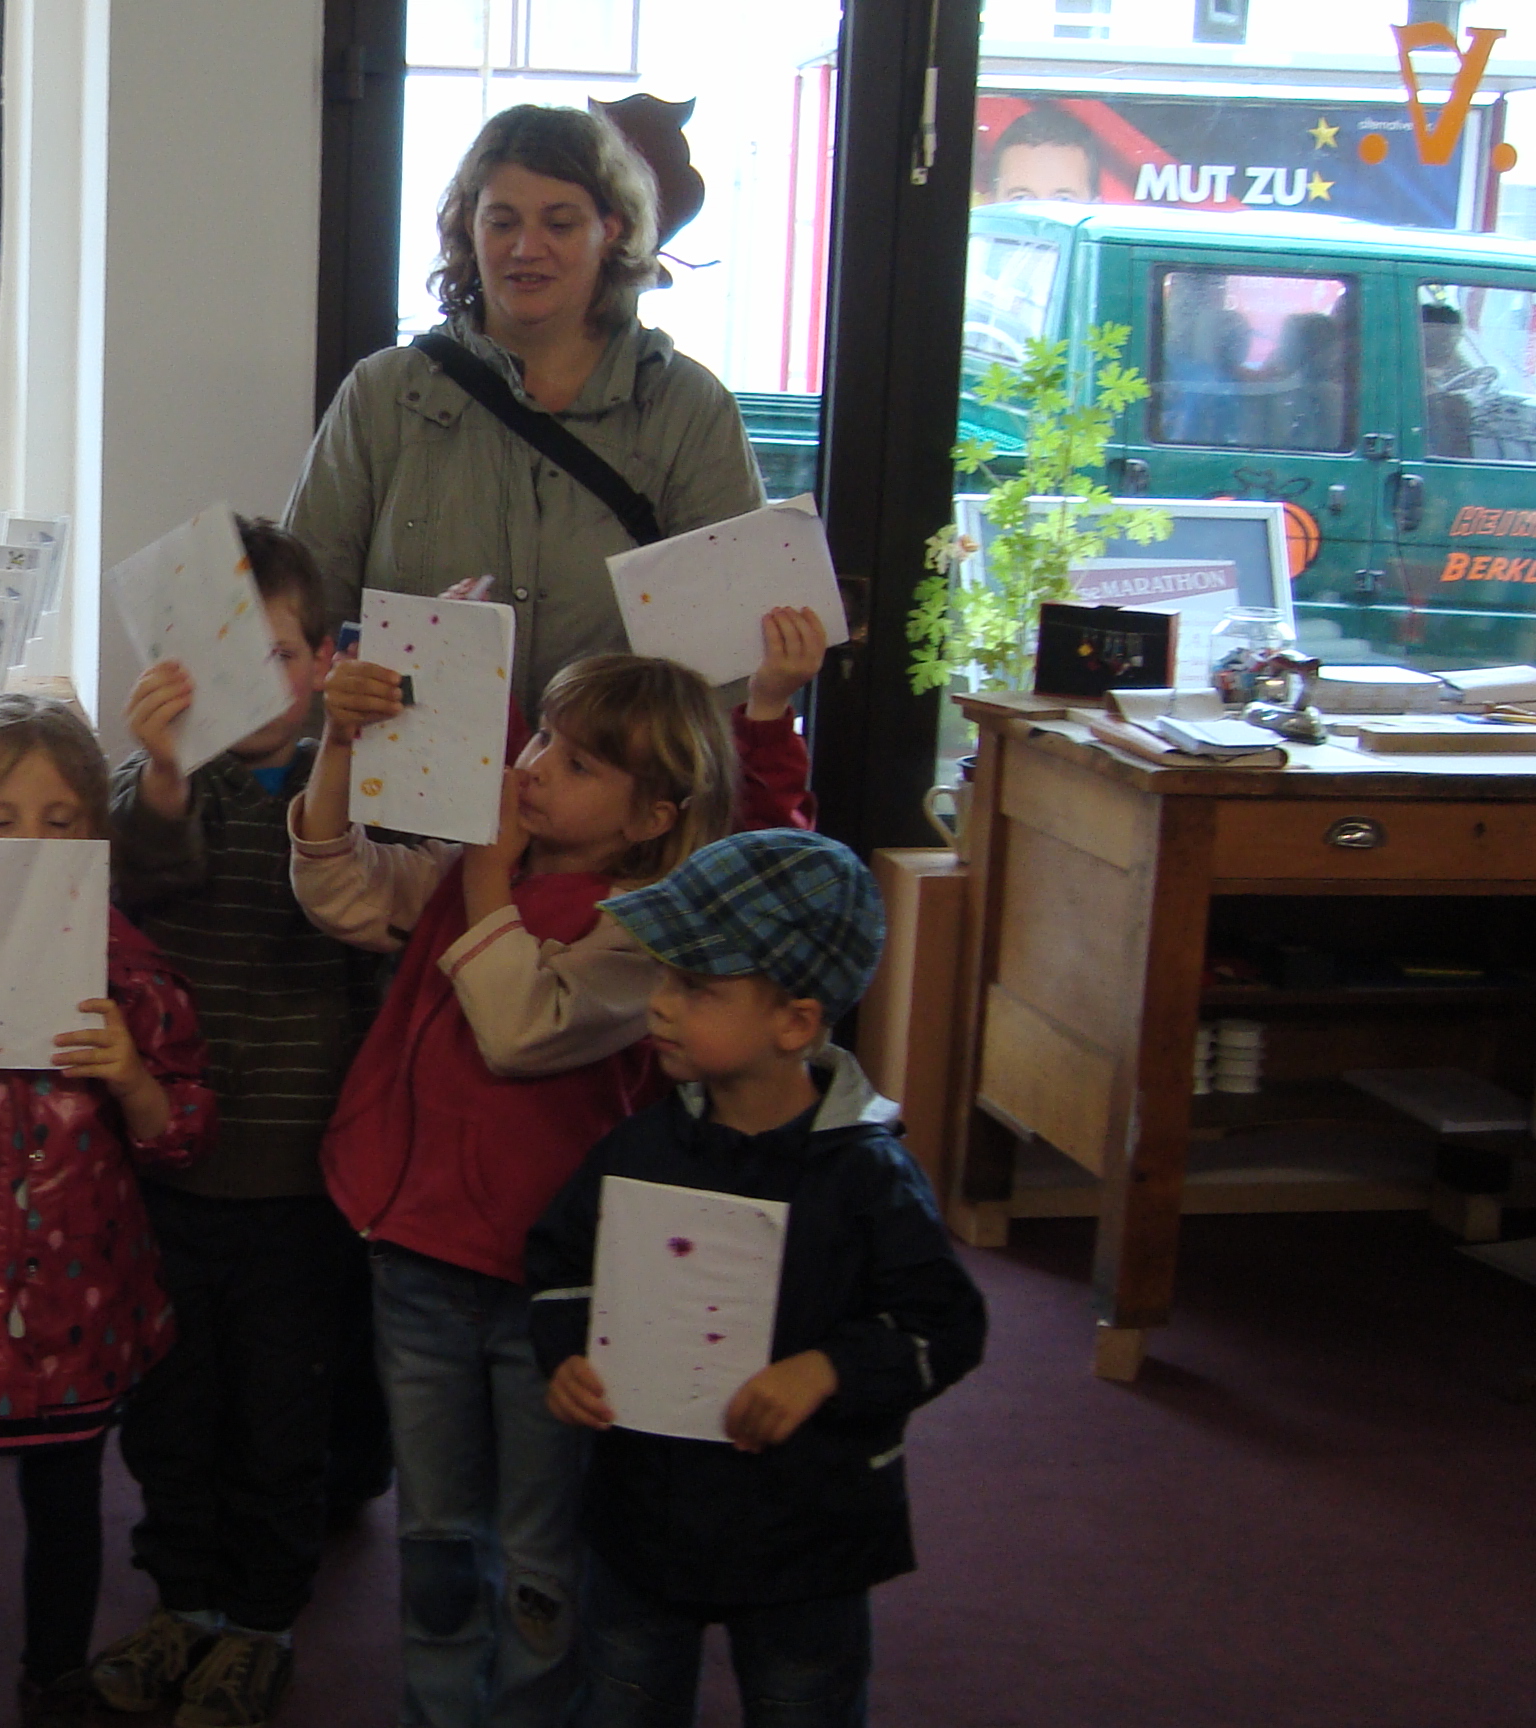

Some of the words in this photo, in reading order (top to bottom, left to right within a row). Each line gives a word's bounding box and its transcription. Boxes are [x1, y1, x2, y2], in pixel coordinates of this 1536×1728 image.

[1134, 163, 1235, 204] MUT
[1241, 165, 1311, 206] ZU
[1077, 569, 1226, 599] seMARATHON
